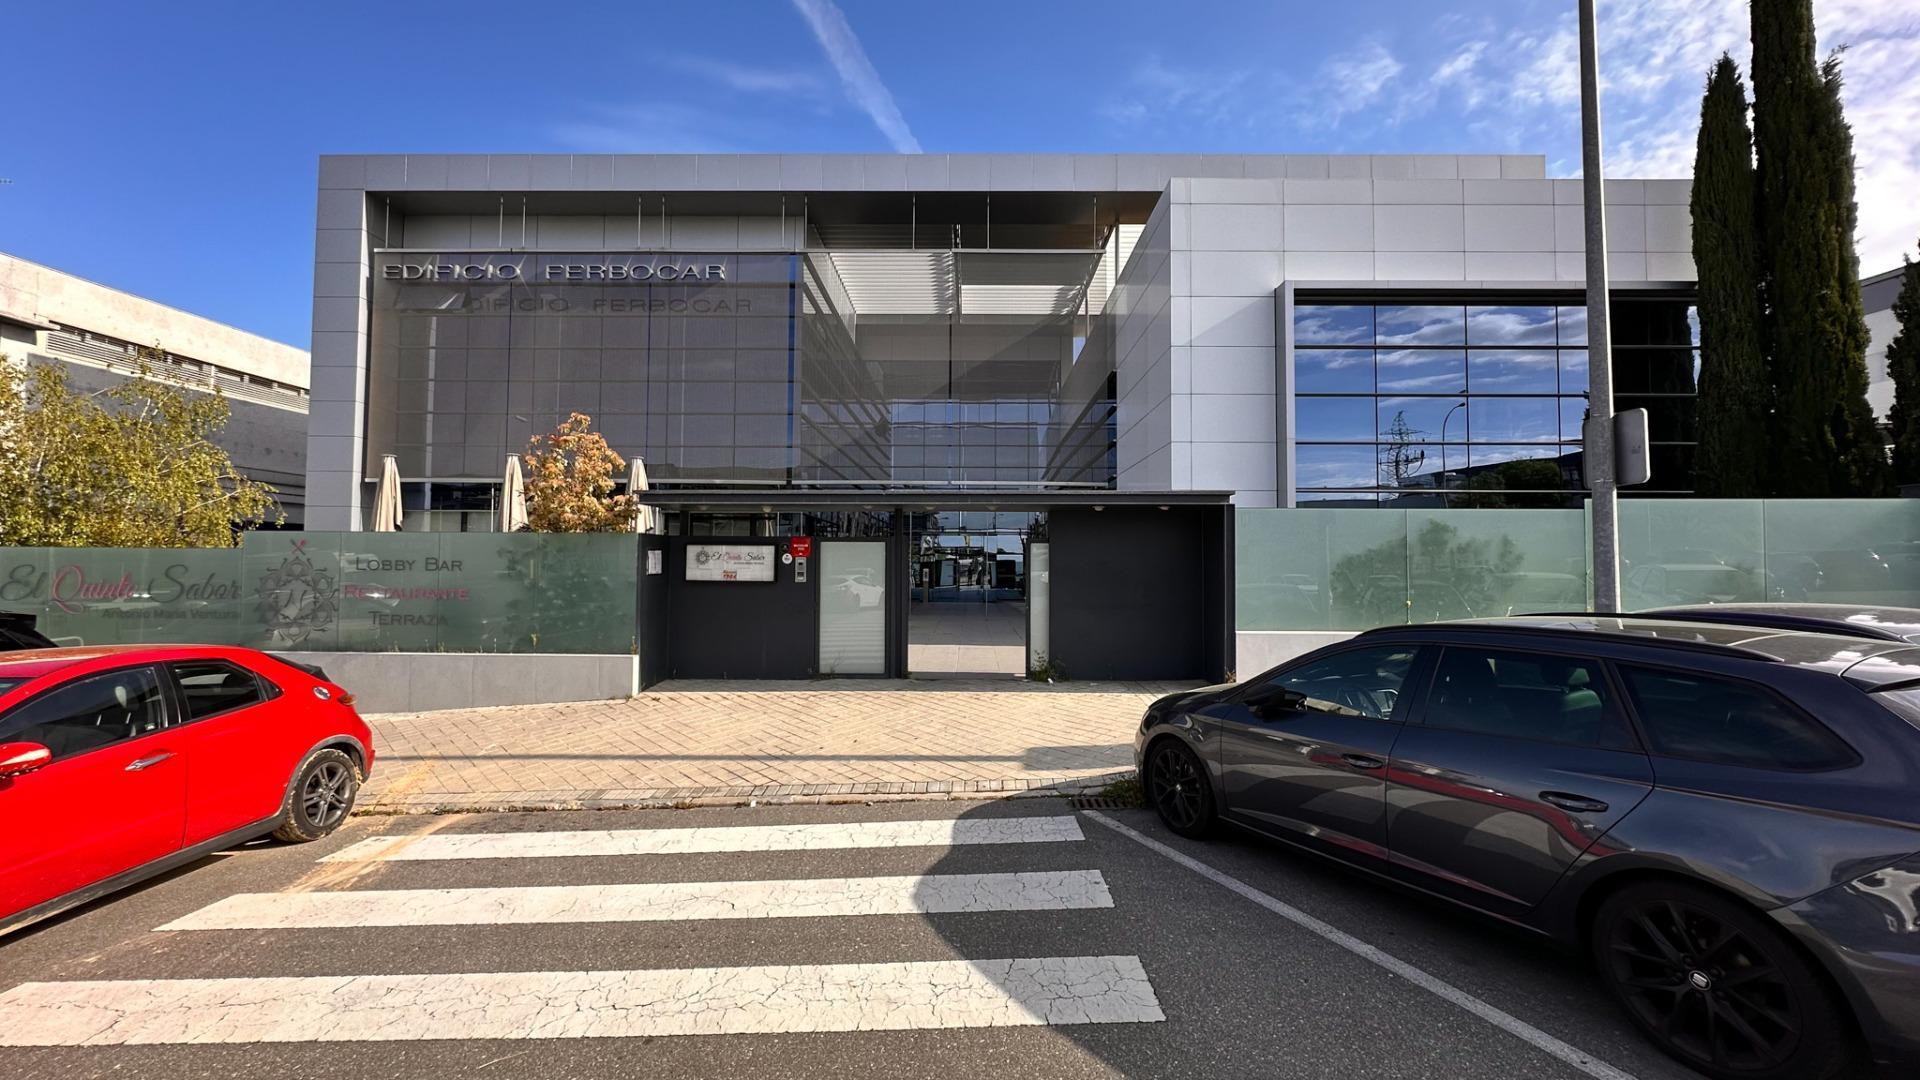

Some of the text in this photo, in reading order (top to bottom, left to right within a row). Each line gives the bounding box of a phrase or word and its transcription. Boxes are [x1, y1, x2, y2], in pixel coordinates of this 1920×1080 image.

[382, 264, 726, 280] EDIFICIO FERBOCAR
[355, 557, 464, 571] LOBBY BAR
[1, 564, 48, 601] El
[147, 564, 241, 602] Sabor
[368, 610, 449, 626] TERRAZA
